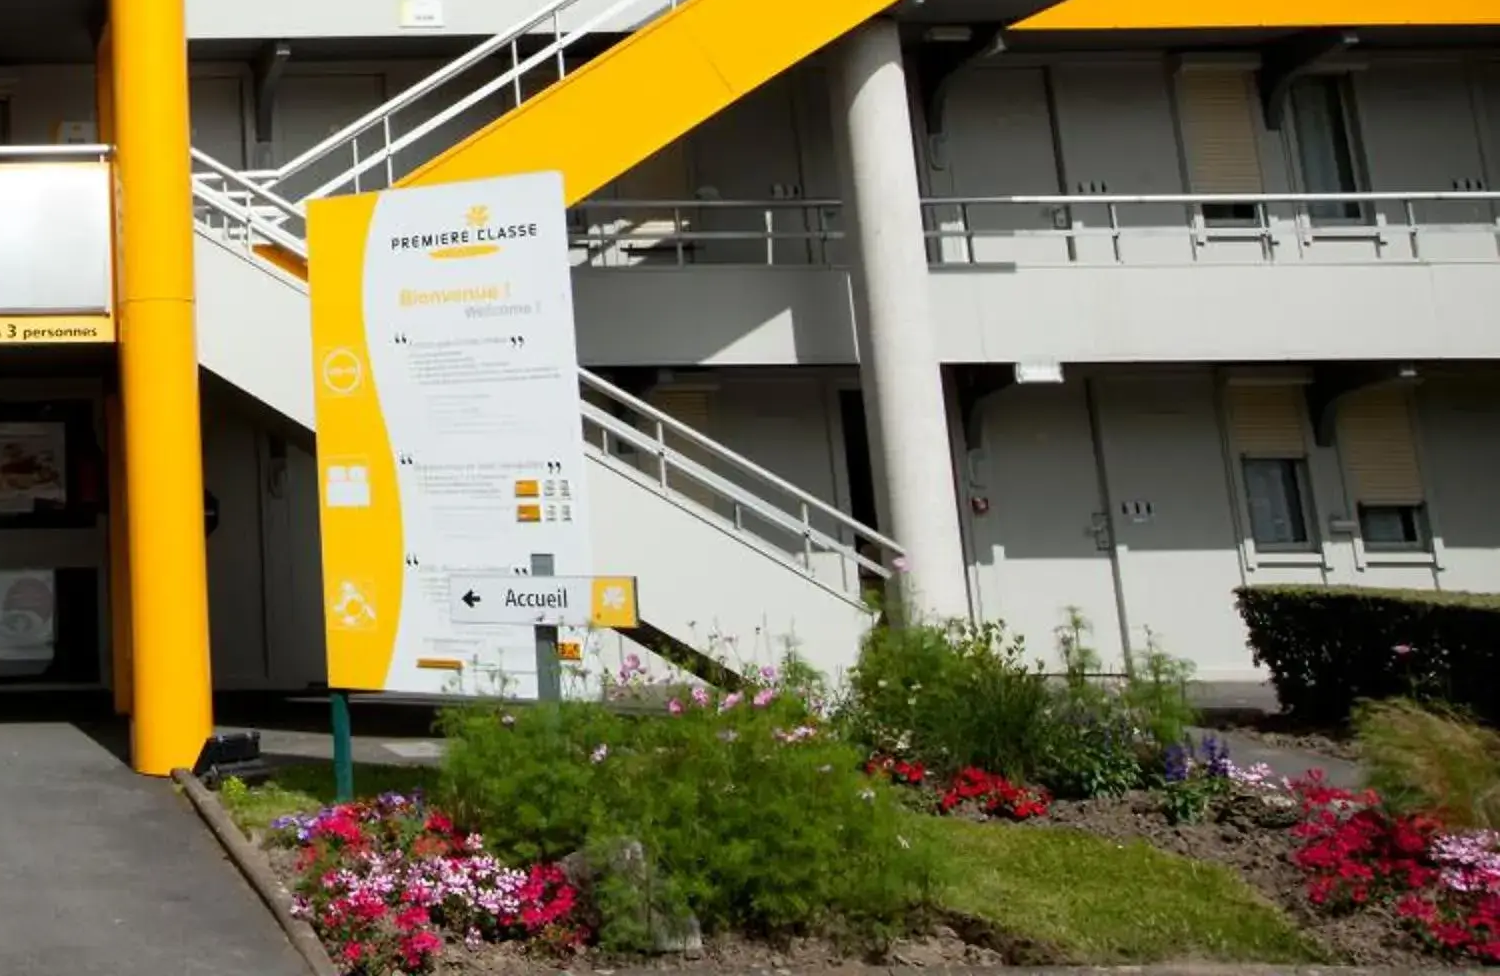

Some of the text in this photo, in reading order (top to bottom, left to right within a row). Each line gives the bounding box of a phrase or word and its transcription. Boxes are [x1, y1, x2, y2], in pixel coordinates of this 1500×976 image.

[391, 223, 537, 250] PREMIERE CLASSE
[7, 324, 16, 338] 3
[22, 327, 97, 340] personnes
[505, 587, 568, 609] Accueil
